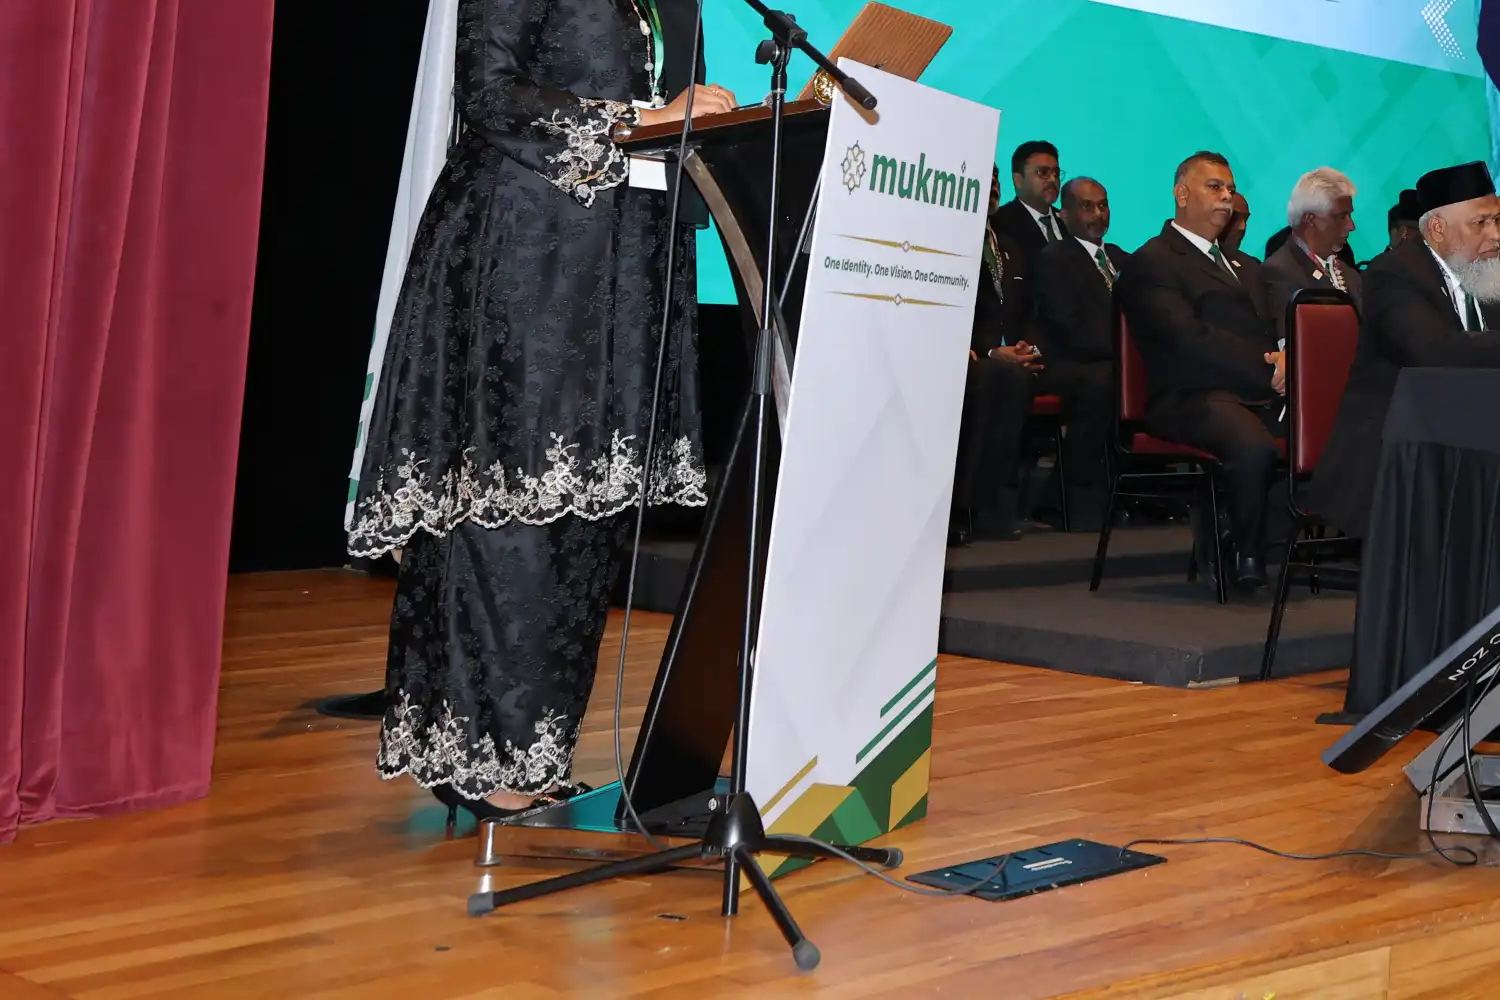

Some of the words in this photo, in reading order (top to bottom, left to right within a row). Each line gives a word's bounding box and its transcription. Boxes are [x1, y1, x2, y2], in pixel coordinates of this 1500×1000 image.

[869, 152, 981, 213] mukmin
[824, 255, 841, 270] One
[841, 257, 873, 279] Identity.
[874, 263, 889, 278] One
[890, 264, 913, 280] Vision.
[914, 268, 928, 283] One
[929, 272, 970, 289] Community.
[1447, 646, 1490, 681] ZON
